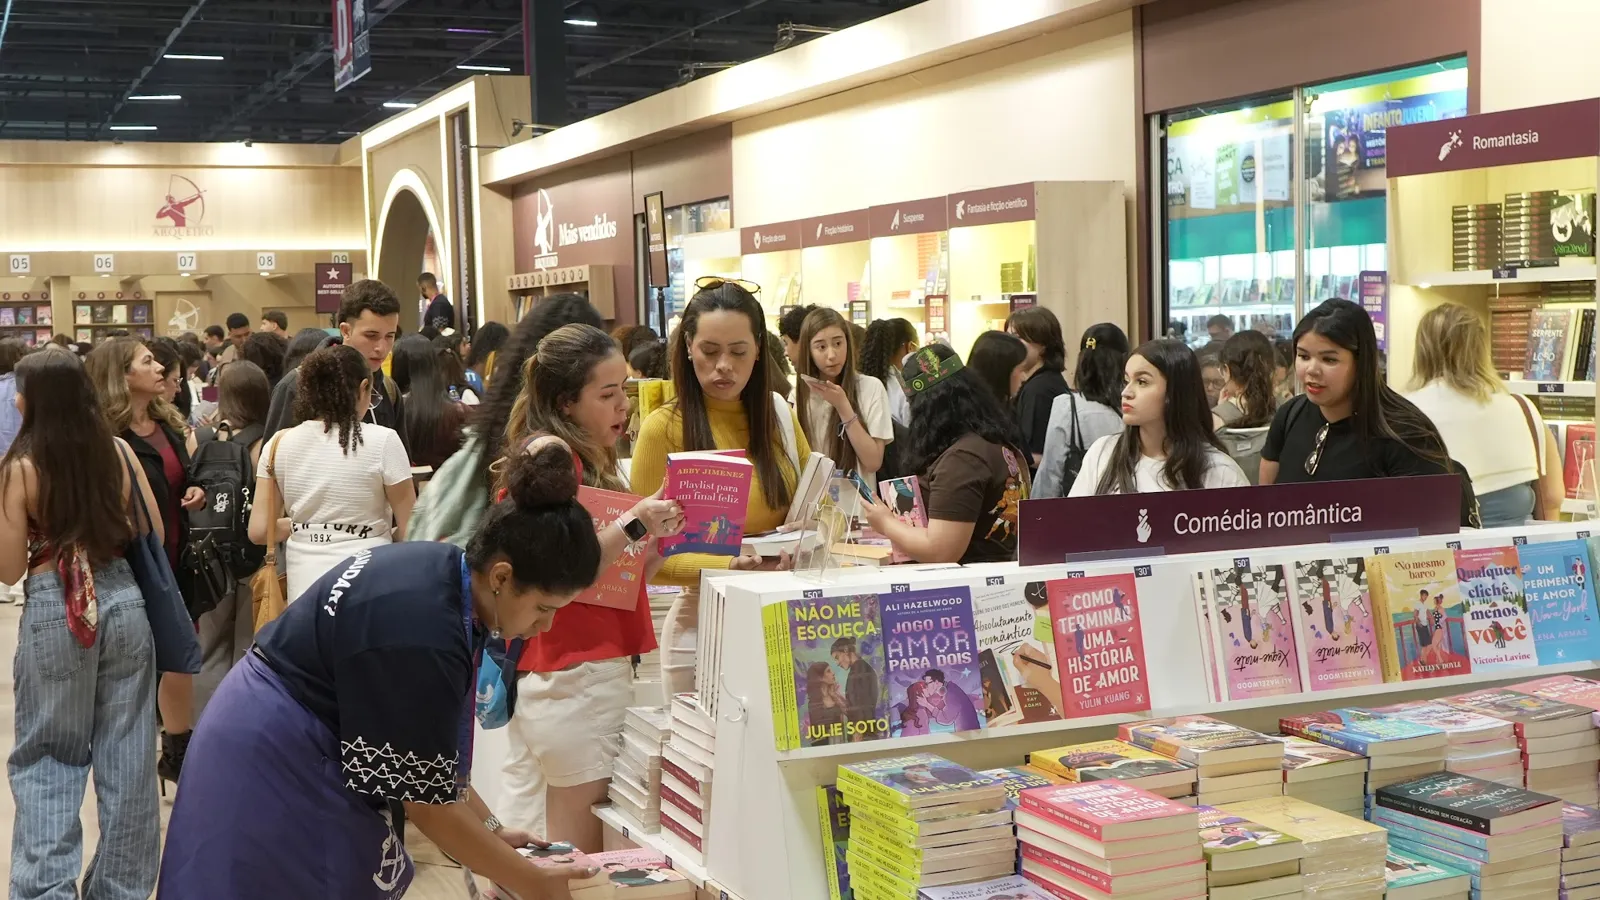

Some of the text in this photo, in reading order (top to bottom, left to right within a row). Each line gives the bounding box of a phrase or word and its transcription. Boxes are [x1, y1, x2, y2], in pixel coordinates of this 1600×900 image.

[1473, 130, 1539, 150] Romantasia
[967, 203, 986, 214] Fantasia
[990, 200, 1004, 212] ficção
[1005, 198, 1027, 210] científica
[903, 213, 924, 224] Suspense
[152, 227, 214, 240] ARQUEIRO
[558, 213, 617, 246] Mais vendidos
[12, 258, 28, 270] 05
[96, 257, 112, 269] 06
[179, 255, 194, 268] 07
[258, 255, 274, 267] 08
[1532, 329, 1563, 337] SERPENTE
[702, 469, 744, 479] JIMENEZ
[679, 480, 738, 494] Playlist para
[693, 491, 716, 501] final
[718, 492, 739, 504] feliz
[1173, 502, 1363, 536] Comédia romântica
[310, 534, 332, 542] 199X
[1395, 559, 1446, 570] No mesmo
[1537, 565, 1554, 574] UM
[1408, 569, 1436, 580] barco
[1456, 565, 1518, 582] Qualquer
[1523, 574, 1585, 589] PERIMENTO
[602, 584, 627, 593] ARMAS
[1468, 581, 1513, 598] clichê,
[1525, 588, 1576, 602] DE AMOR
[885, 597, 963, 612] ALI HAZELWOOD
[1072, 588, 1114, 611] COMO
[1562, 589, 1588, 621] York
[795, 602, 861, 622] NÃO ME
[1058, 605, 1133, 634] TERMINAR
[1470, 606, 1518, 620] menos
[892, 615, 961, 635] JOGO DE
[973, 610, 1033, 632] Absolutamente
[797, 620, 877, 641] ESQUEÇA
[979, 624, 1032, 647] romântico
[1468, 618, 1527, 644] você
[1558, 628, 1588, 638] ARMAS
[887, 630, 970, 658] AMOR
[1083, 629, 1115, 650] UMA
[1233, 644, 1291, 672] Xeque-mate
[1314, 636, 1373, 664] Xeque-mate
[888, 651, 972, 672] PARA DOIS
[1067, 645, 1134, 675] HISTÓRIA
[1412, 660, 1462, 673] KATELYN DOYLE
[1473, 653, 1531, 664] Victoria Lavine
[1073, 665, 1139, 694] DE AMOR
[1236, 679, 1280, 689] HAZELWOOD
[1318, 671, 1362, 681] HAZELWOOD
[1079, 691, 1130, 710] YULIN KUANG
[805, 717, 889, 740] JULIE SOTO
[909, 778, 994, 794] JULIE SOTO
[1408, 775, 1472, 795] CAÇADOR
[1084, 795, 1123, 806] UMA
[1120, 801, 1170, 814] AMOR
[1419, 806, 1440, 816] CAÇADOR
[1450, 813, 1473, 825] CORAÇÃO
